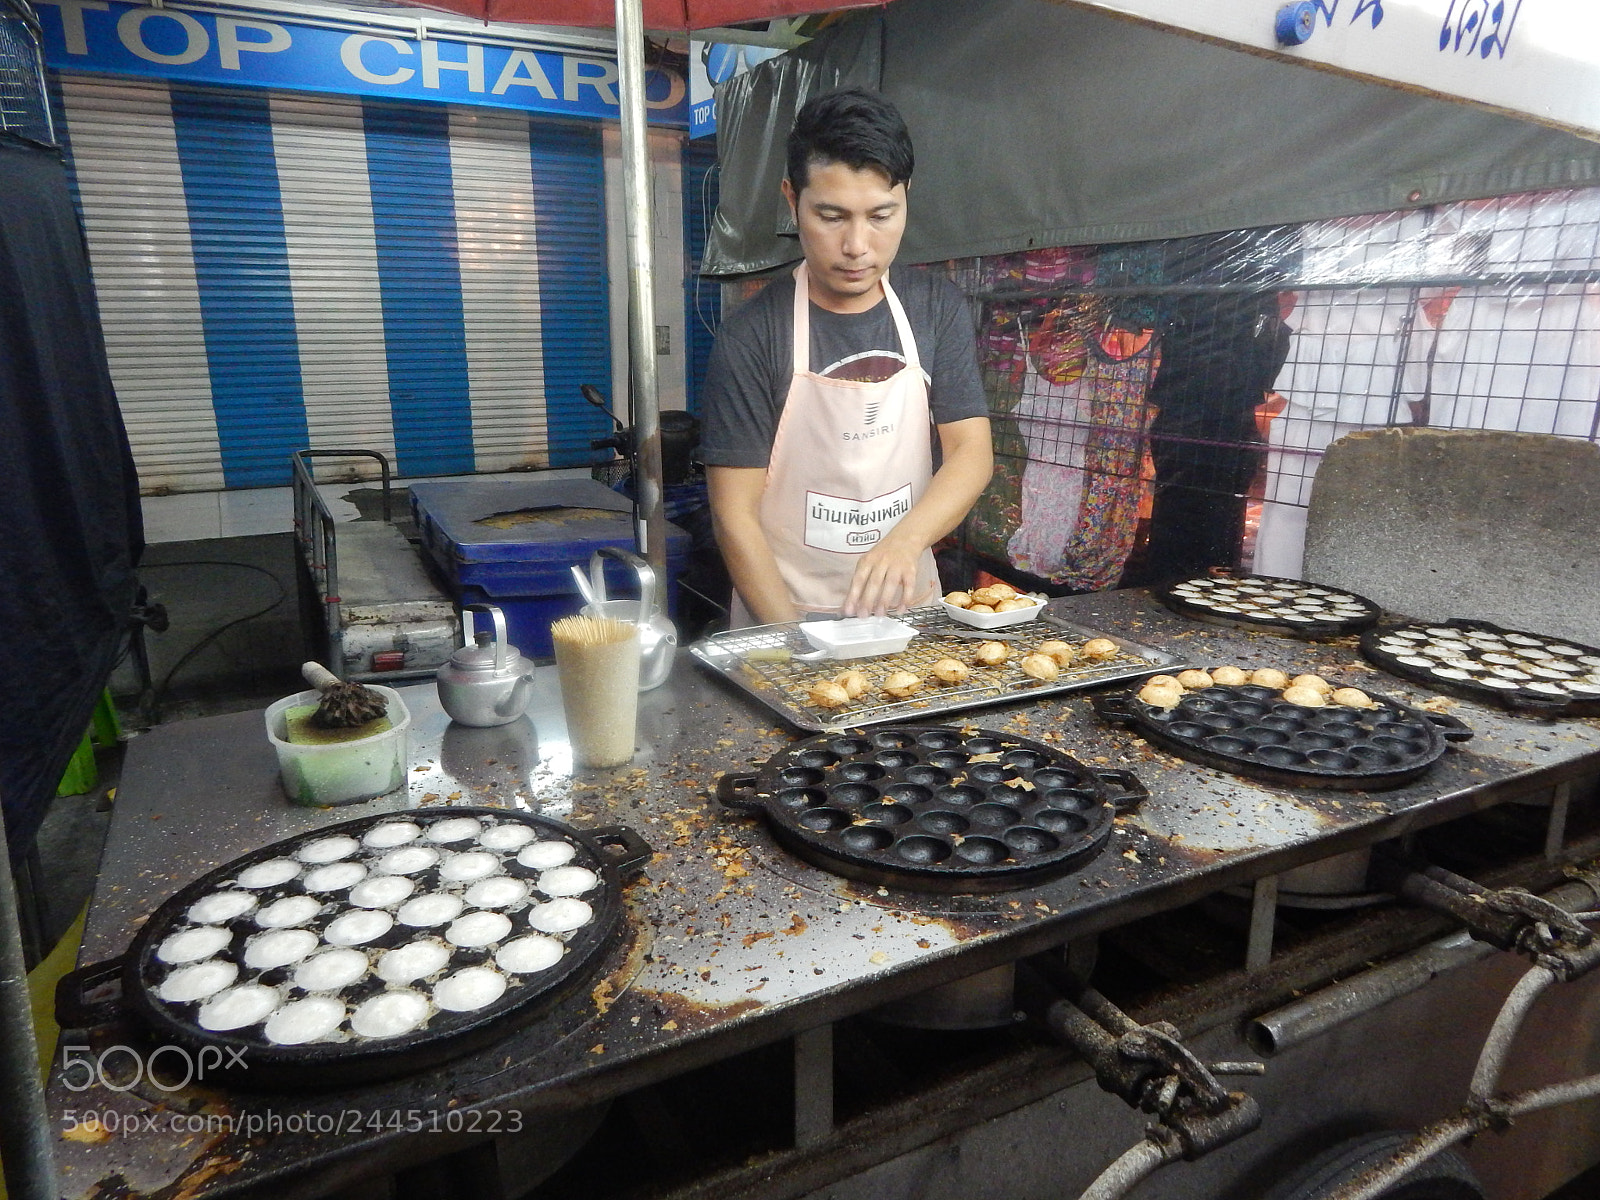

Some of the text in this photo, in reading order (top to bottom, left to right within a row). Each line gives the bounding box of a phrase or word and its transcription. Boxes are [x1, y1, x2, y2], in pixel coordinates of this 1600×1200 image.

[50, 0, 292, 70] TOP
[694, 105, 710, 125] TOP
[842, 423, 894, 441] SANSIRI
